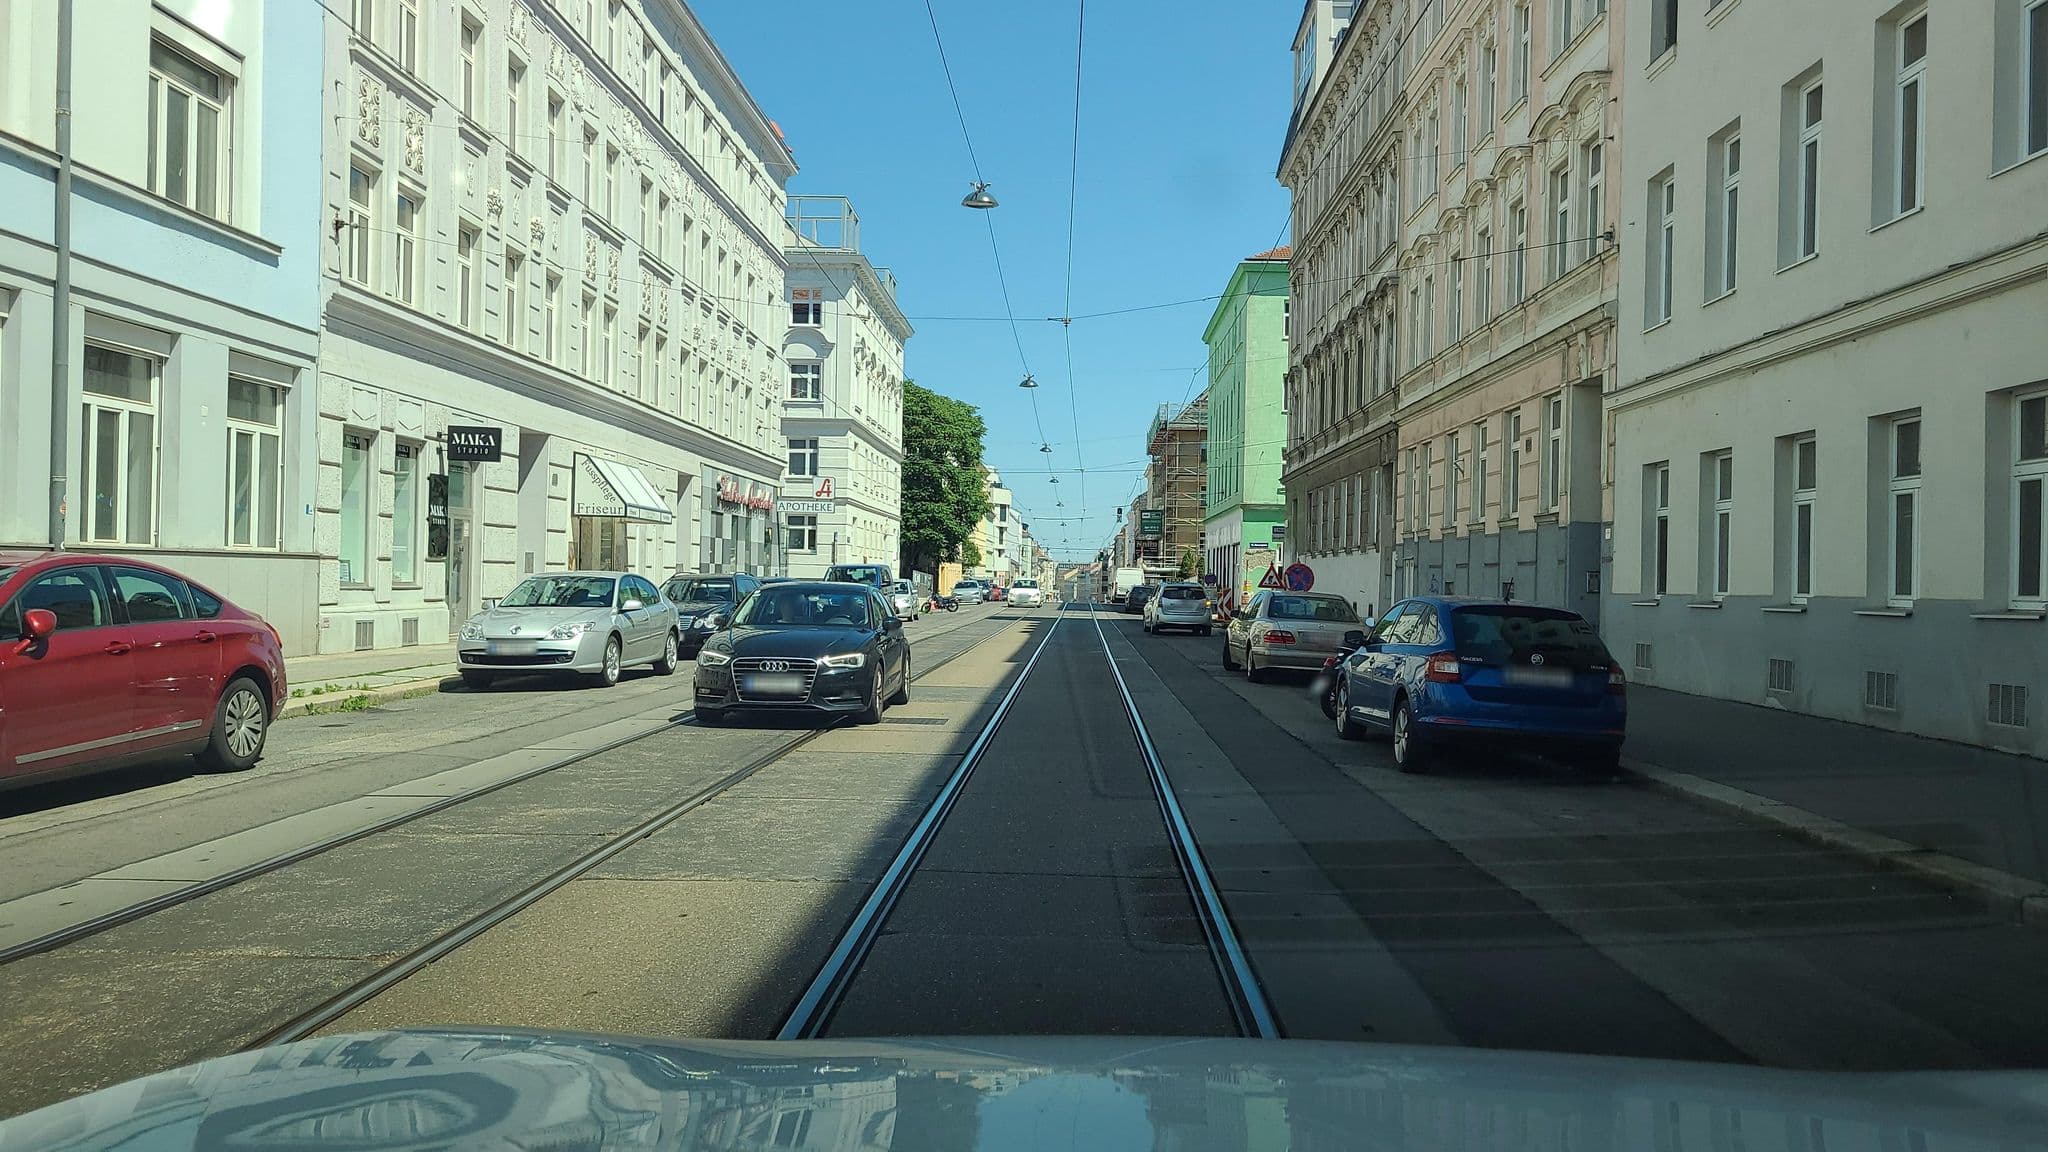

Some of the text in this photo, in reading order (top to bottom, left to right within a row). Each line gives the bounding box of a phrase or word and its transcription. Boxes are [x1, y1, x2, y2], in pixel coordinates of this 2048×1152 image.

[452, 433, 496, 446] MAKA
[457, 447, 489, 455] STUDIO
[581, 459, 616, 503] Fusspflege
[577, 502, 623, 514] Friseur
[778, 502, 832, 511] APOTHEKE
